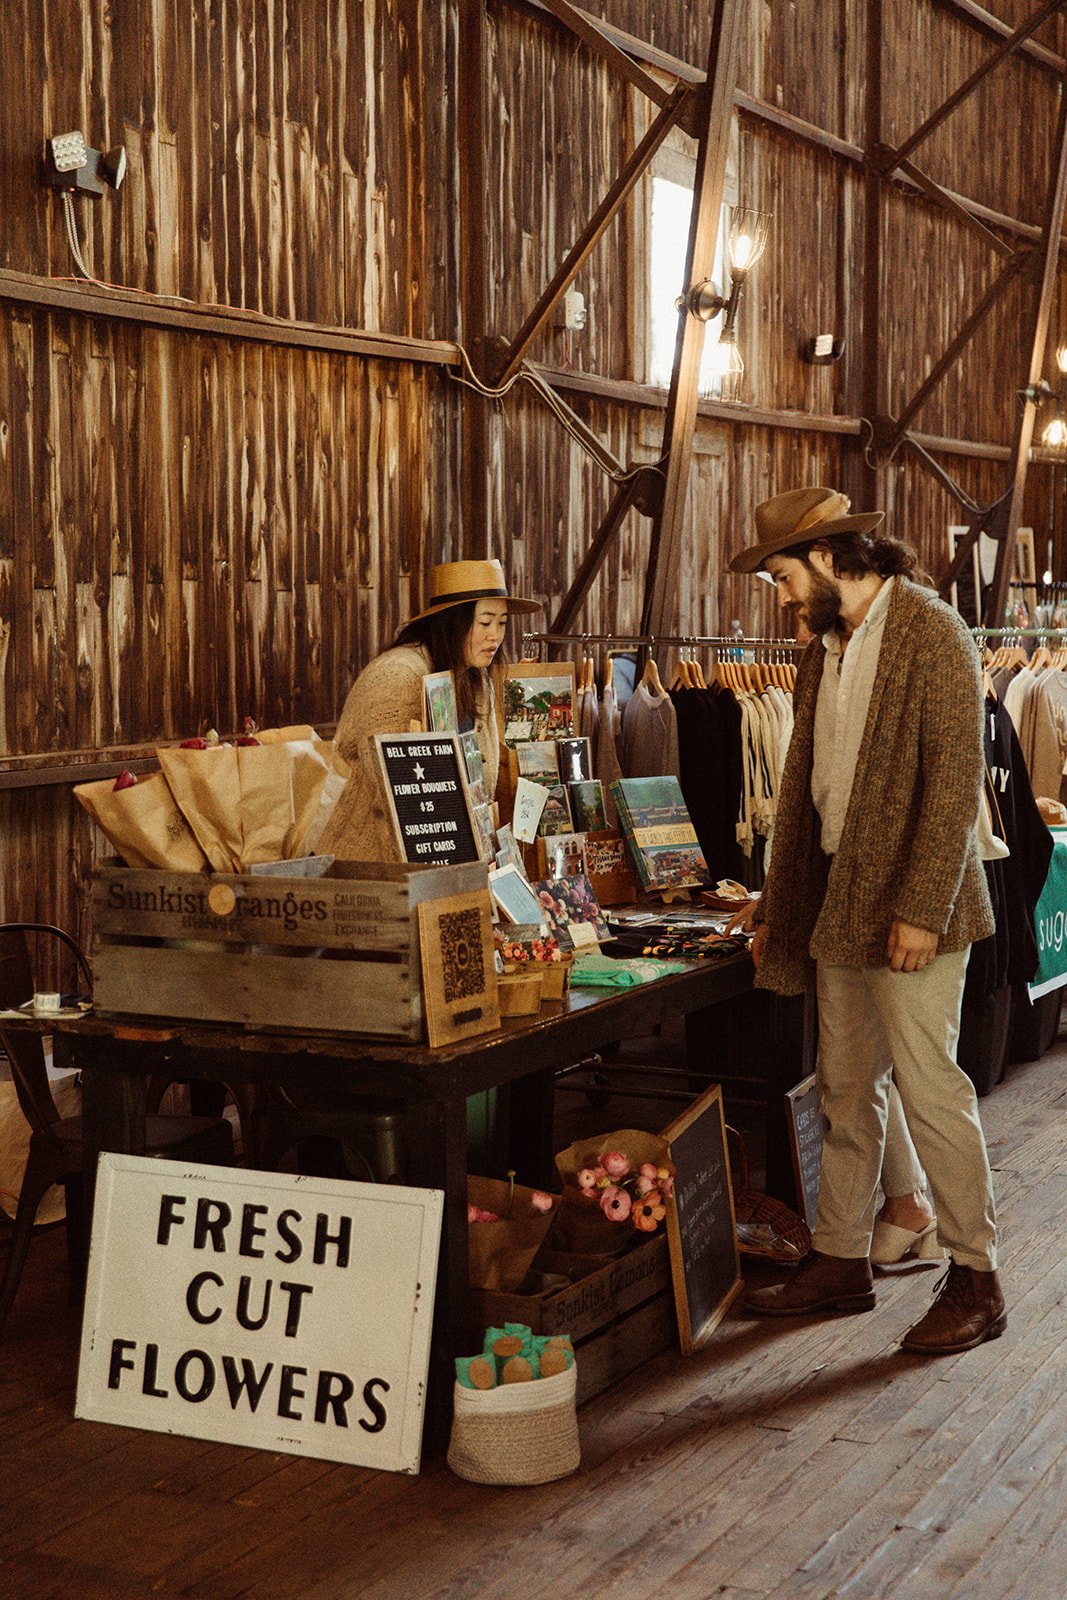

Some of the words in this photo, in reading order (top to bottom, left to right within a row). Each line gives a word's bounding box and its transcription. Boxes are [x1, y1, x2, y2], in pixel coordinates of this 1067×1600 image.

[386, 747, 406, 758] BELL
[408, 746, 432, 757] CREEK
[434, 744, 454, 756] FARM
[394, 784, 421, 796] FLOWER
[422, 781, 457, 794] BOUQUETS
[405, 821, 458, 836] SUBSCRIPTION
[416, 842, 432, 854] GIFT
[433, 840, 456, 852] CARDS
[107, 883, 207, 913] Sunkist
[156, 1194, 352, 1268] FRESH
[186, 1271, 314, 1337] CUT
[108, 1338, 390, 1433] FLOWERS
